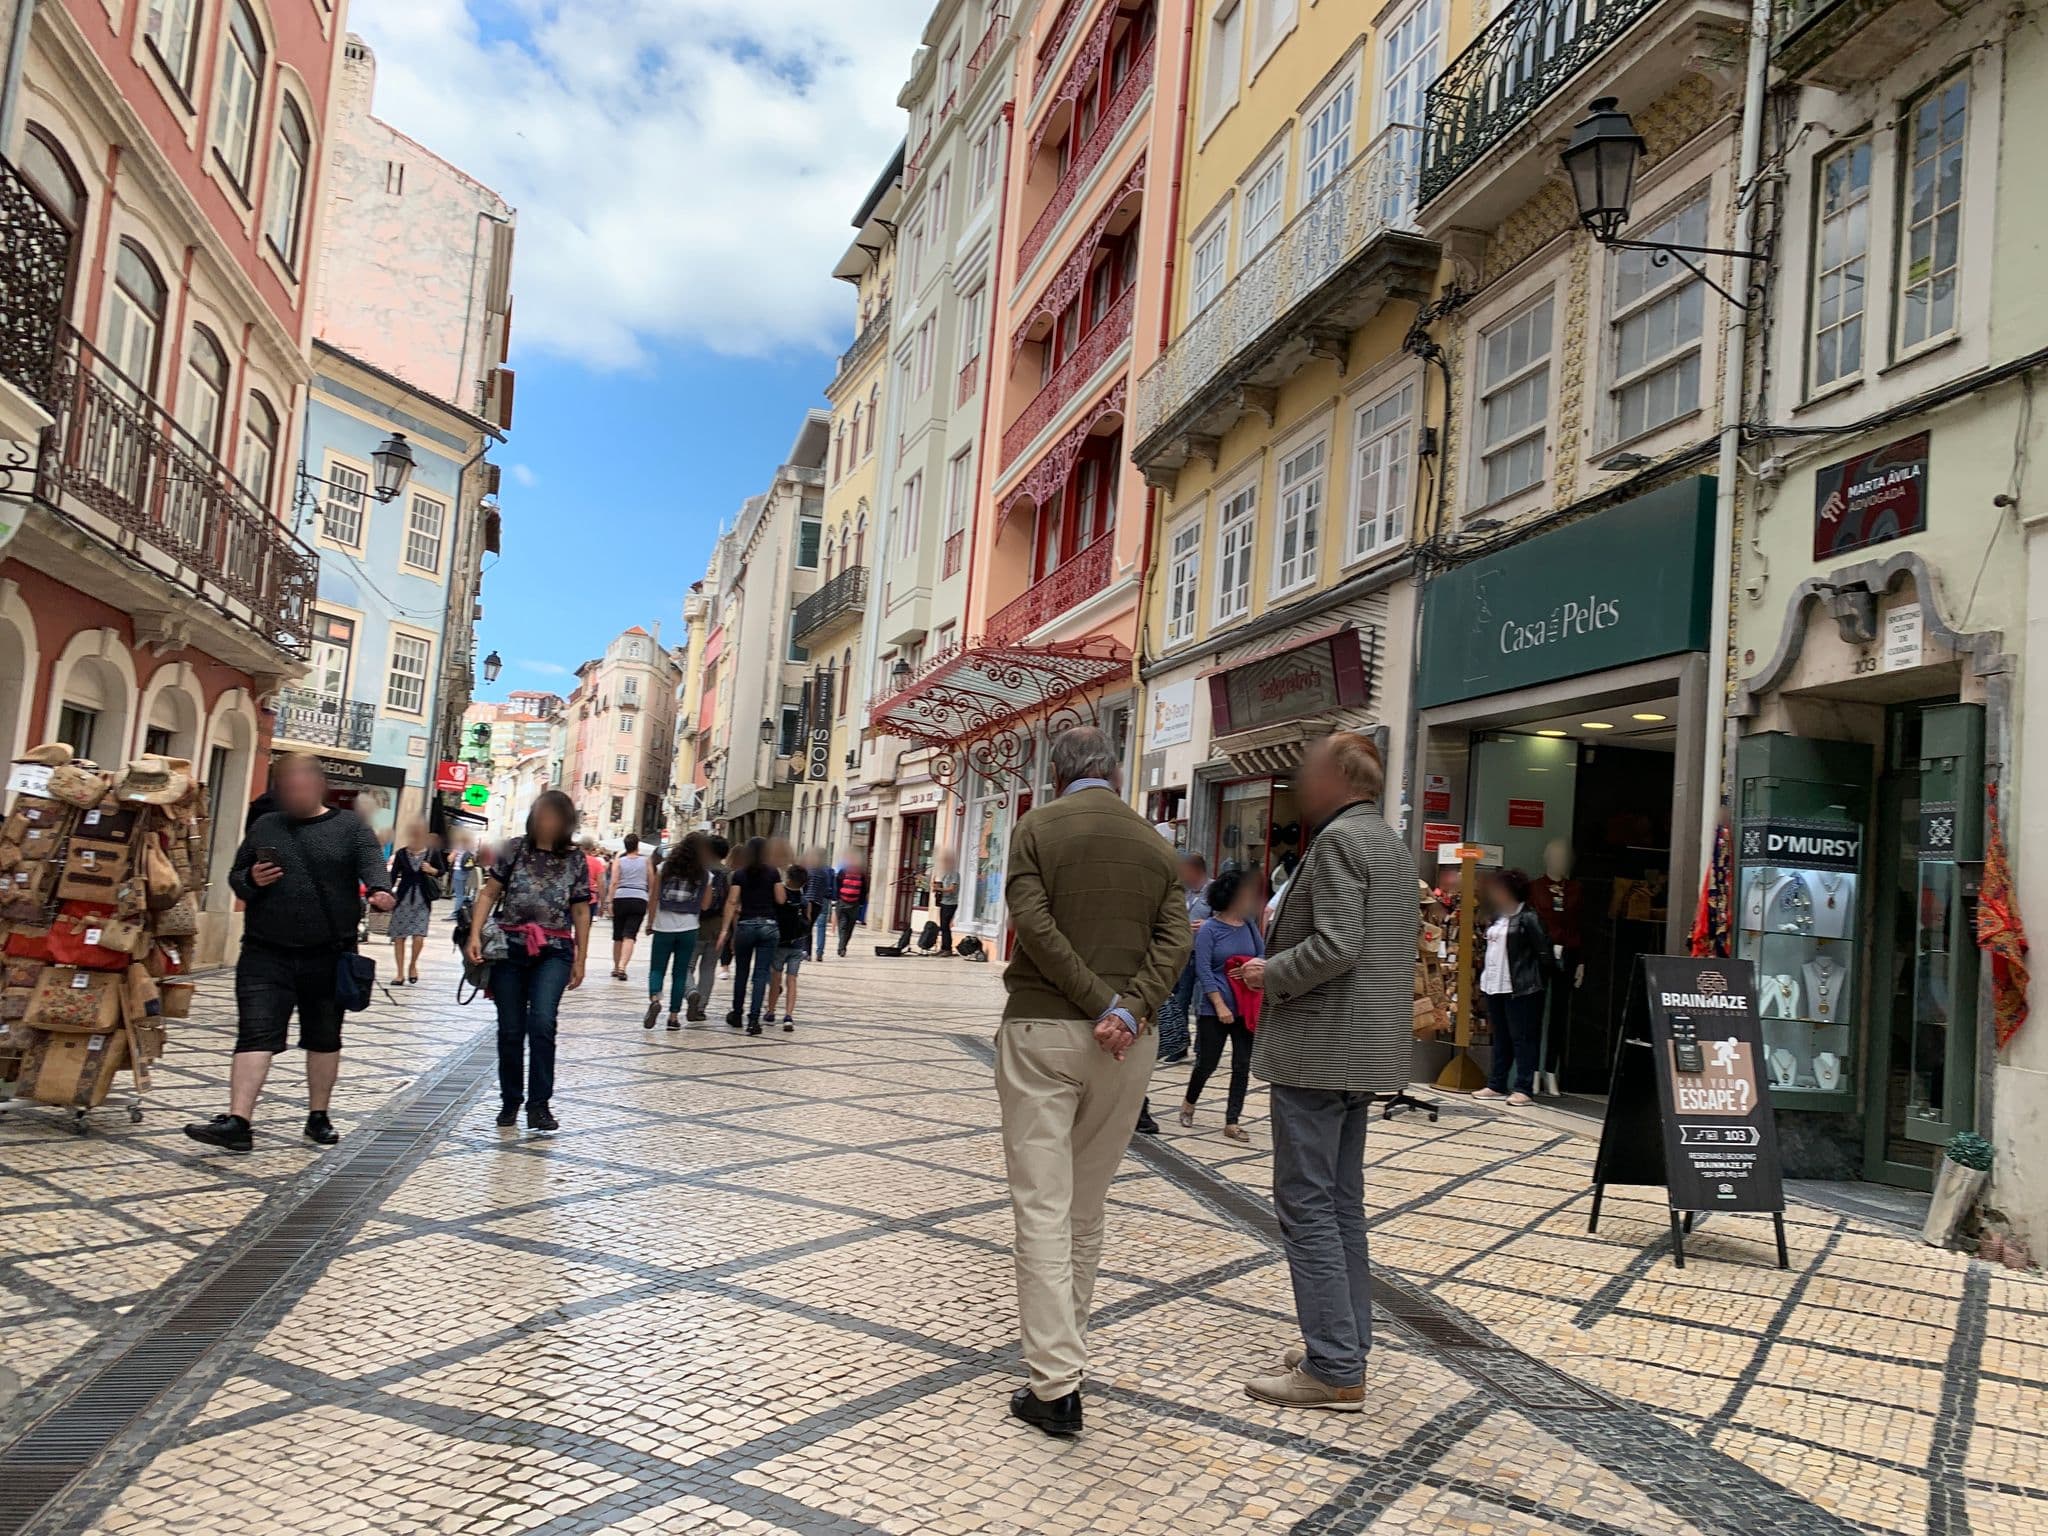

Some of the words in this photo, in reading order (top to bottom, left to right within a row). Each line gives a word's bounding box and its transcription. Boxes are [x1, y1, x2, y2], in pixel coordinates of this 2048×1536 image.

[1847, 477, 1885, 498] MARTA
[1887, 465, 1920, 485] ÁVILA
[1848, 486, 1906, 512] ADVOGADA
[1501, 620, 1546, 653] Casa
[1563, 595, 1619, 638] Peles
[1768, 834, 1858, 857] D'MURSY
[1661, 993, 1747, 1009] BRAINMAZE
[1677, 1077, 1702, 1088] CAN
[1711, 1078, 1735, 1088] YOU
[1724, 1130, 1746, 1141] 103
